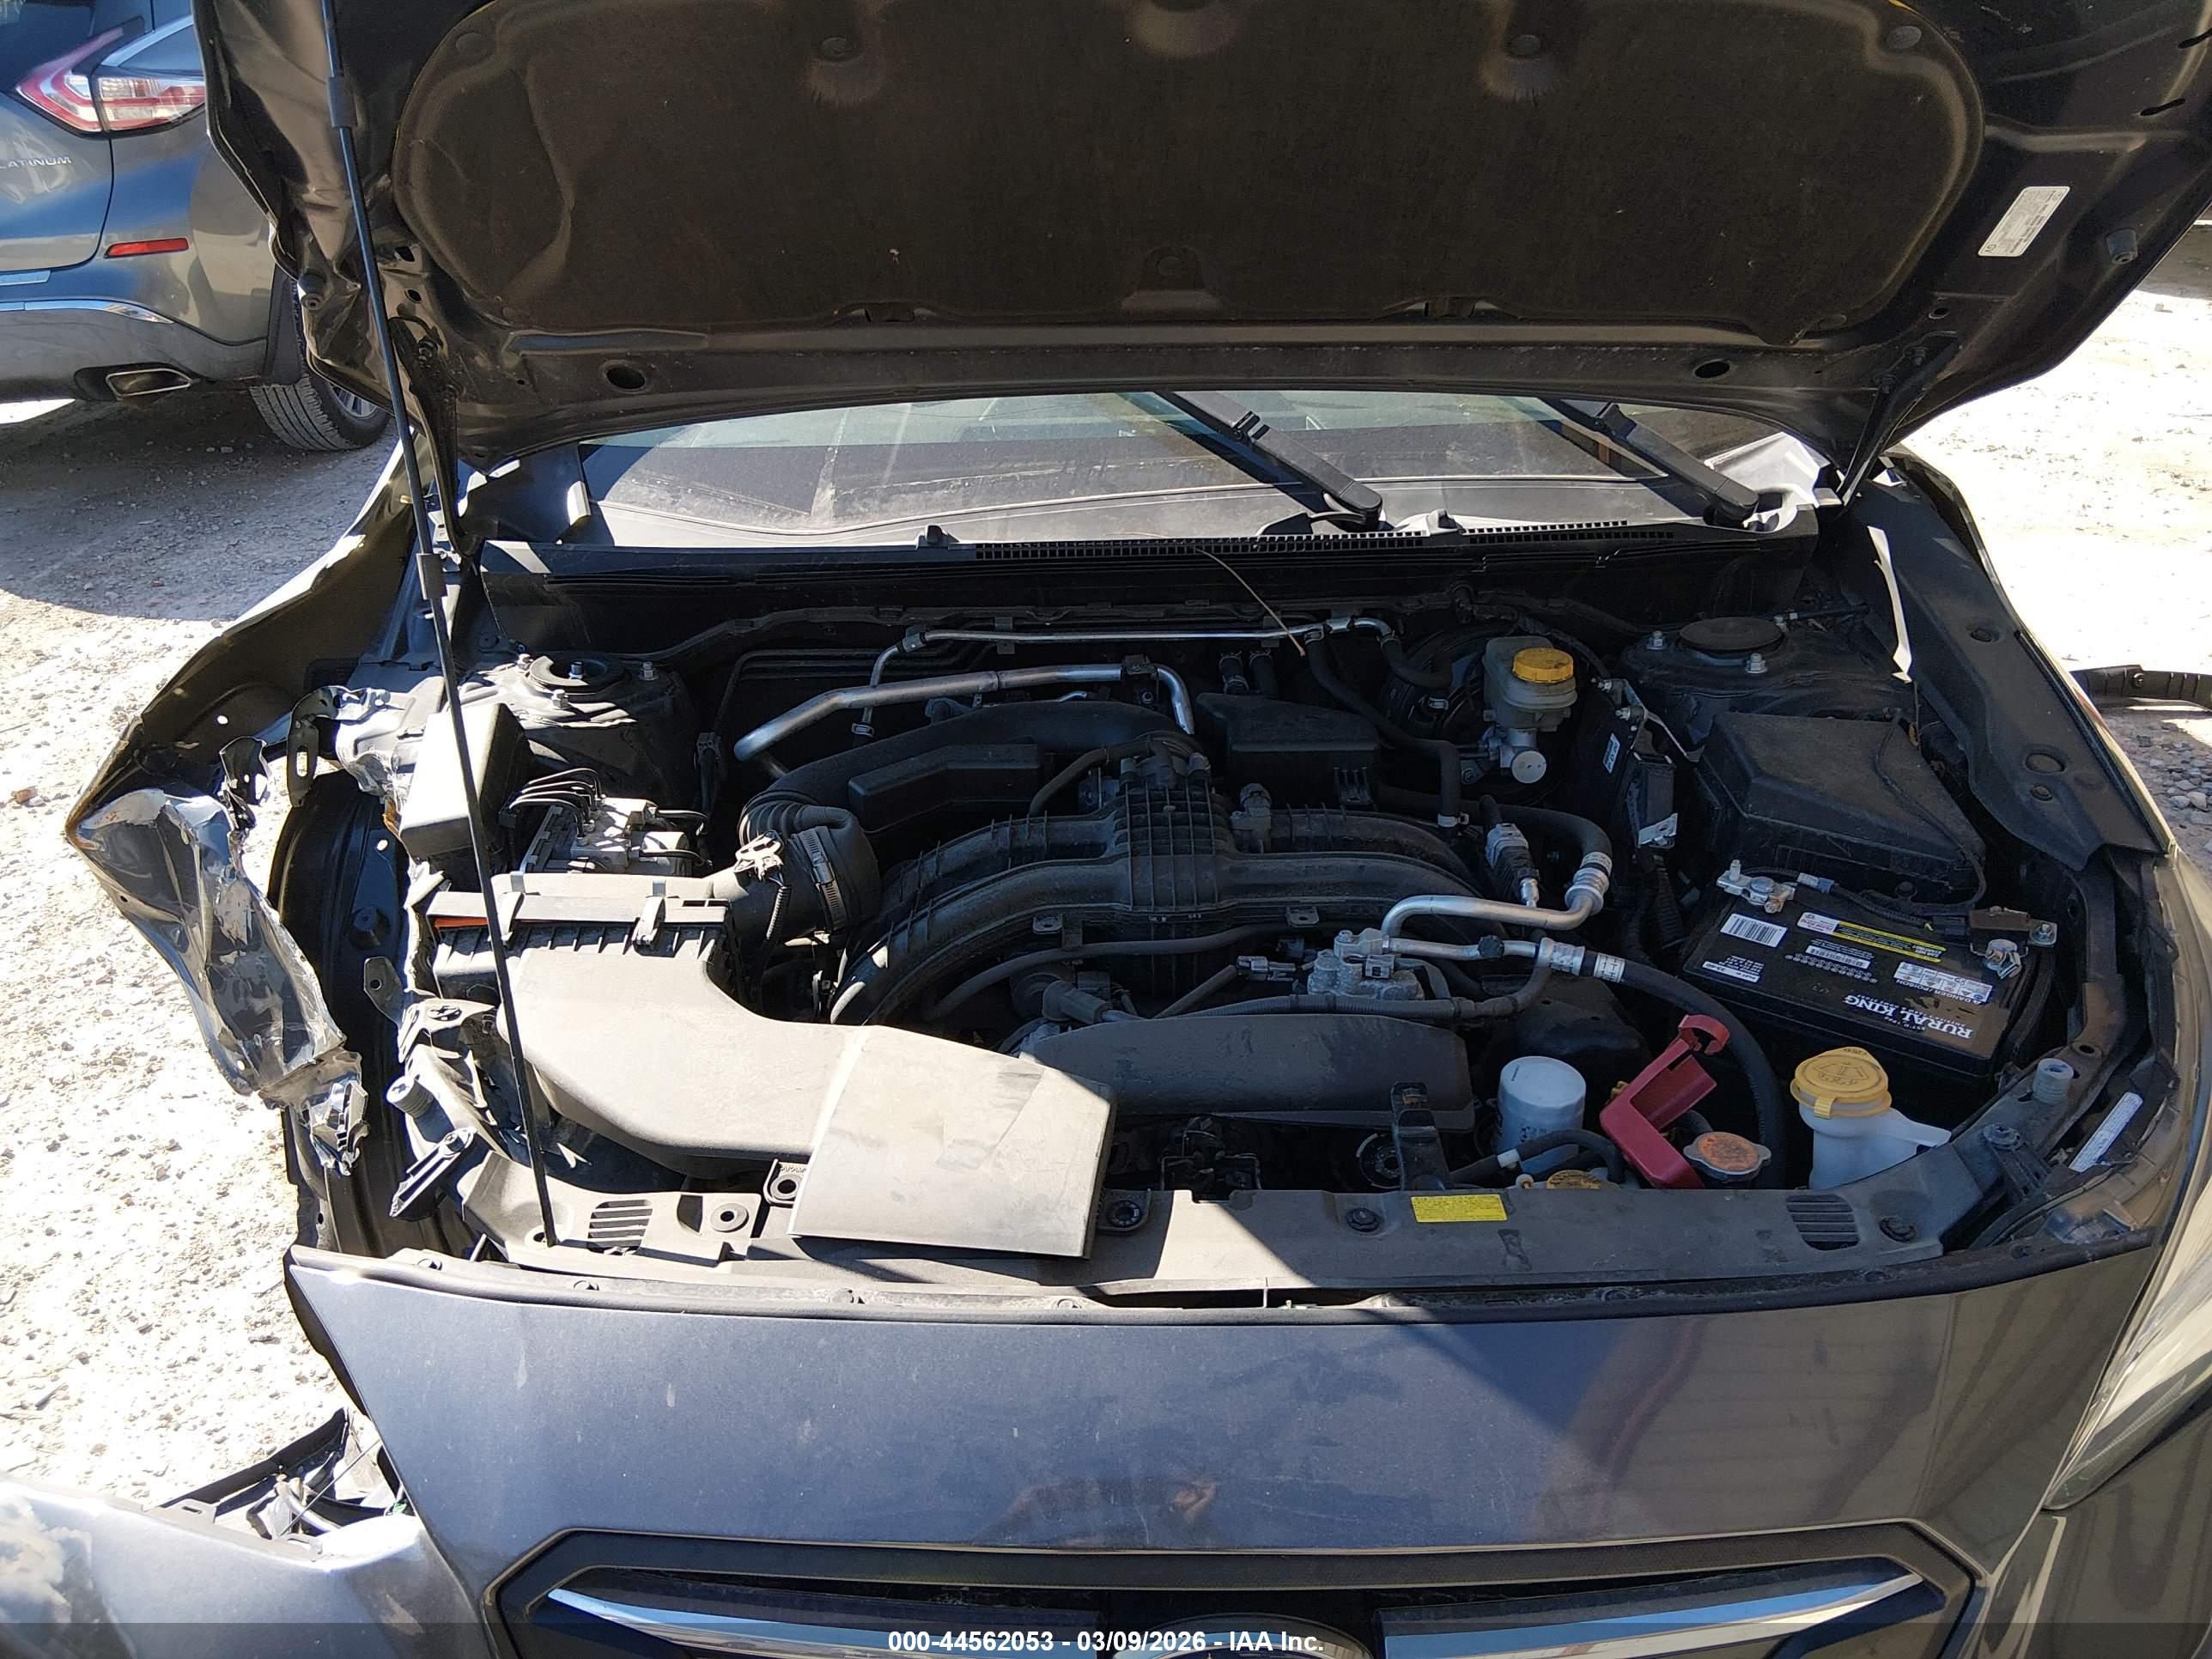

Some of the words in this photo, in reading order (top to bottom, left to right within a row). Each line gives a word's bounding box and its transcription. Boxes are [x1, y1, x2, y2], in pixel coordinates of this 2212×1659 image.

[1844, 994, 1897, 1017] KING
[1934, 989, 1972, 1003] DANGER
[1900, 1010, 1973, 1039] RURAL
